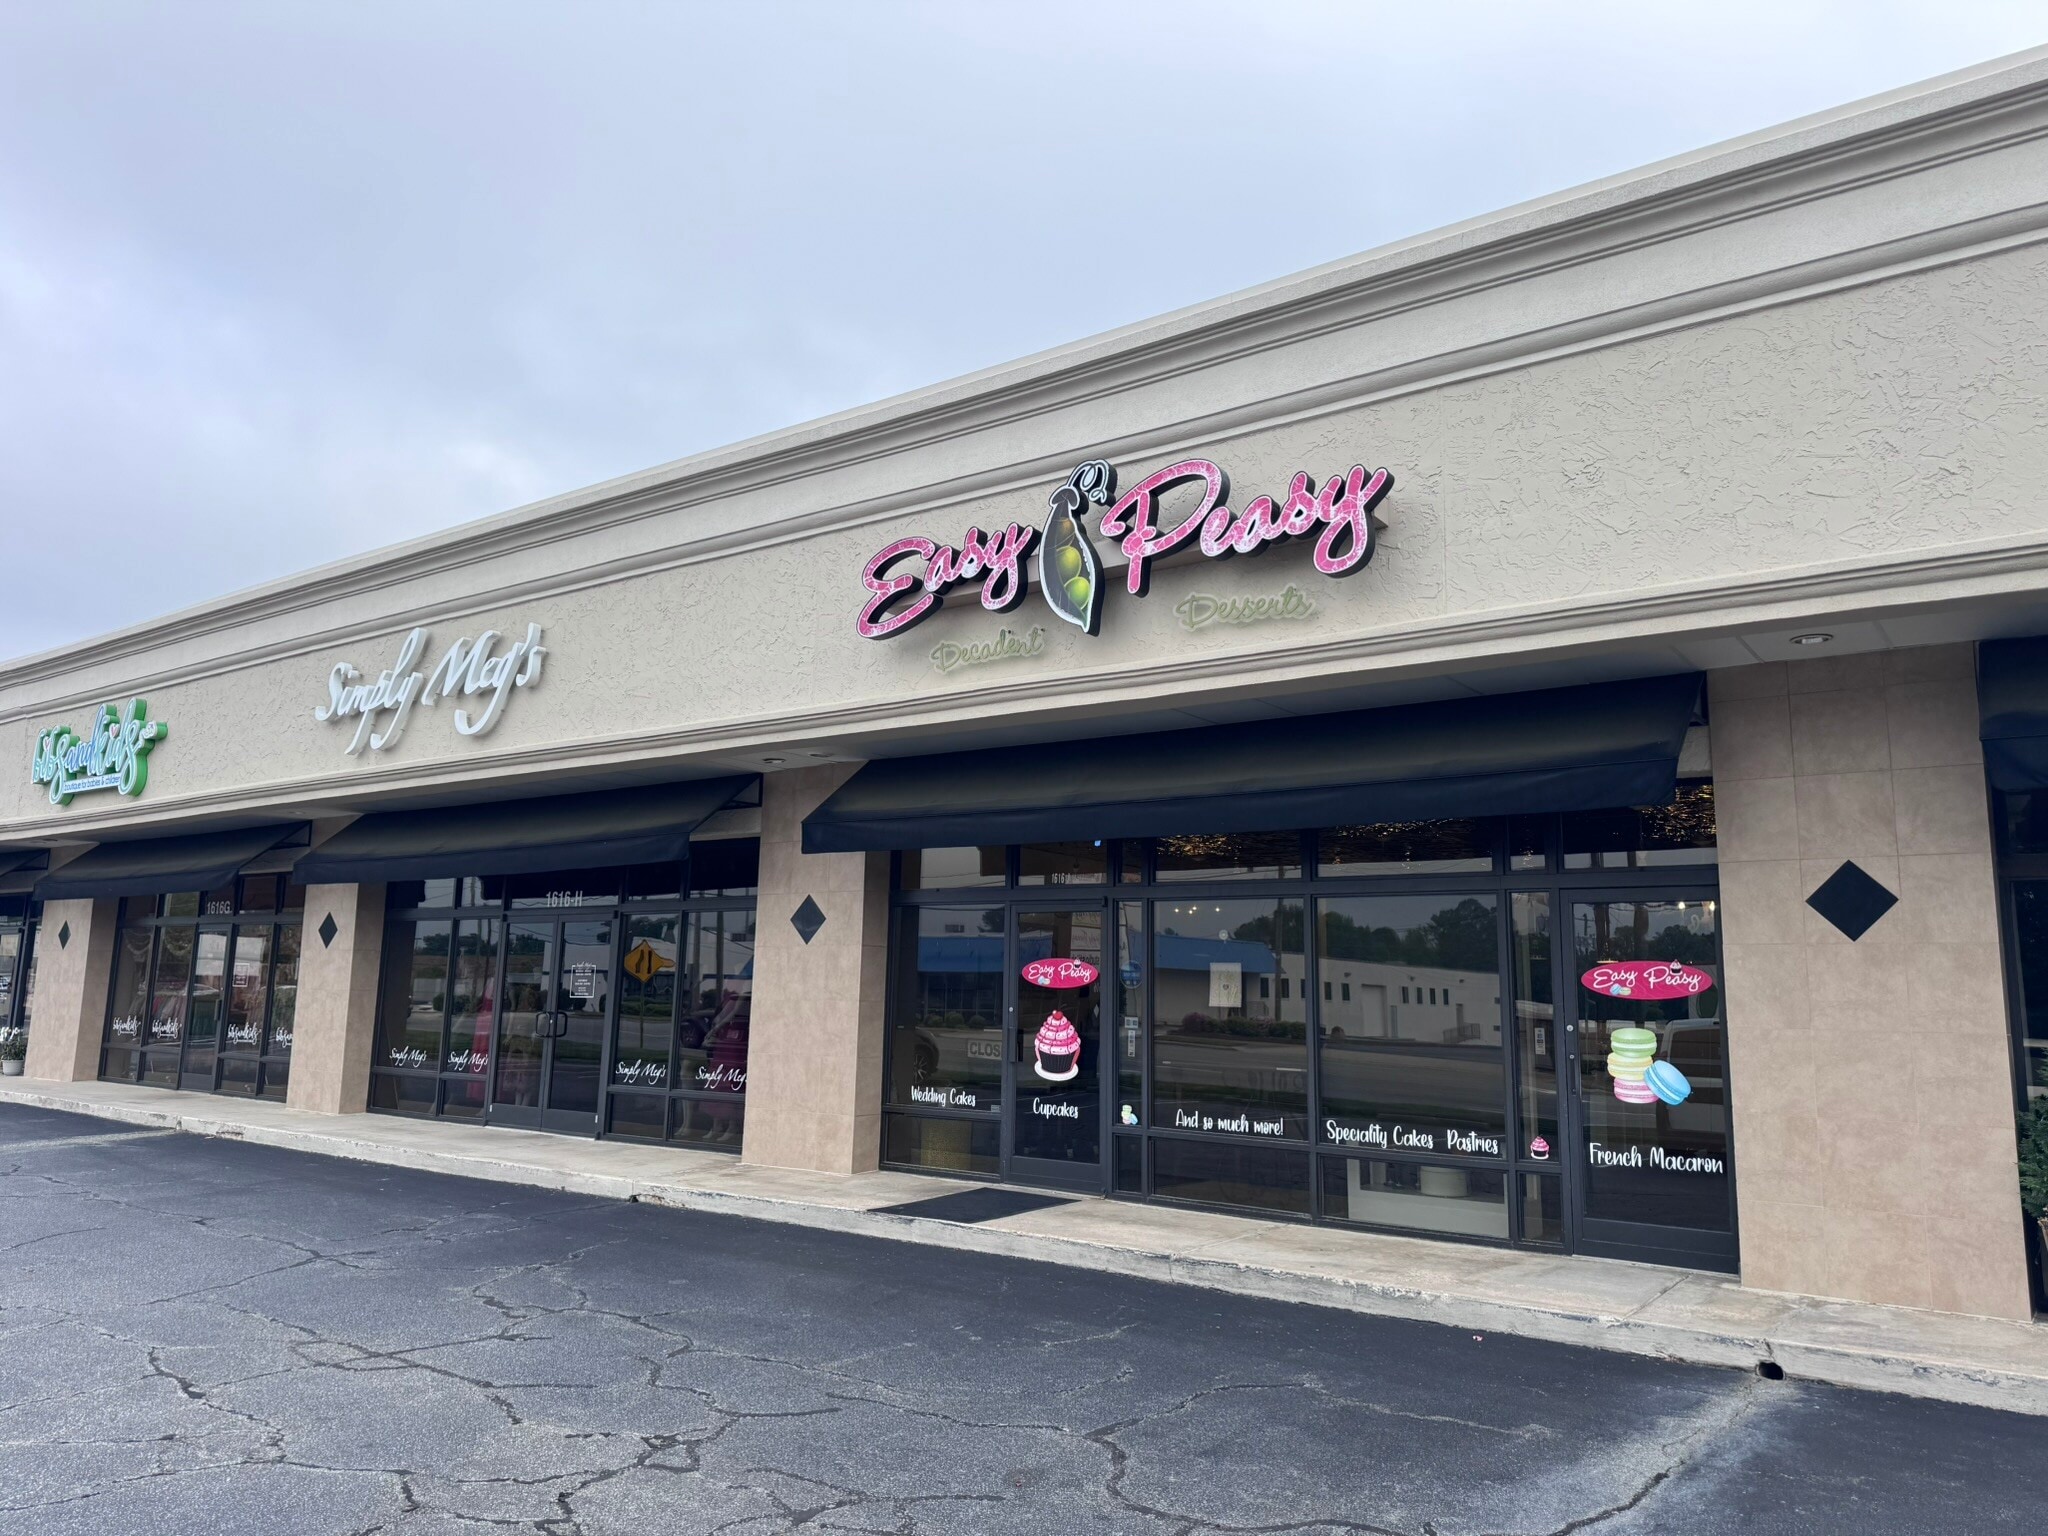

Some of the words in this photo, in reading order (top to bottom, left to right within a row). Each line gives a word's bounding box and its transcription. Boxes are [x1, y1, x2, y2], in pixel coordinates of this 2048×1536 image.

[856, 522, 1039, 640] Easy
[1100, 459, 1394, 595] Peasy
[1173, 586, 1314, 631] Desserts
[930, 627, 1046, 673] Decadent
[315, 627, 428, 755] Simply
[421, 622, 546, 735] Meg's
[546, 891, 583, 907] 1616-H
[1029, 963, 1055, 980] Easy
[1058, 962, 1092, 982] Peasy
[1593, 968, 1638, 988] Easy
[1643, 965, 1702, 992] Peasy
[389, 1045, 409, 1066] Simply
[408, 1049, 427, 1068] Meg's
[448, 1049, 469, 1071] Simply
[468, 1053, 489, 1072] Meg's
[969, 1041, 1000, 1057] CLOS
[615, 1059, 641, 1083] Simply
[640, 1063, 666, 1085] Meg's
[695, 1064, 724, 1089] Simply
[723, 1068, 747, 1091] Meg
[911, 1085, 947, 1108] Wedding
[949, 1087, 976, 1107] Cakes
[1033, 1097, 1079, 1119] Cupcakes
[1175, 1108, 1199, 1128] And
[1203, 1116, 1213, 1130] so
[1217, 1114, 1249, 1133] much
[1253, 1117, 1284, 1136] more!
[1326, 1119, 1387, 1148] Speciality
[1393, 1125, 1433, 1149] Cakes
[1447, 1129, 1499, 1154] Pastries
[1589, 1142, 1642, 1168] French
[1649, 1146, 1724, 1174] Macaron
